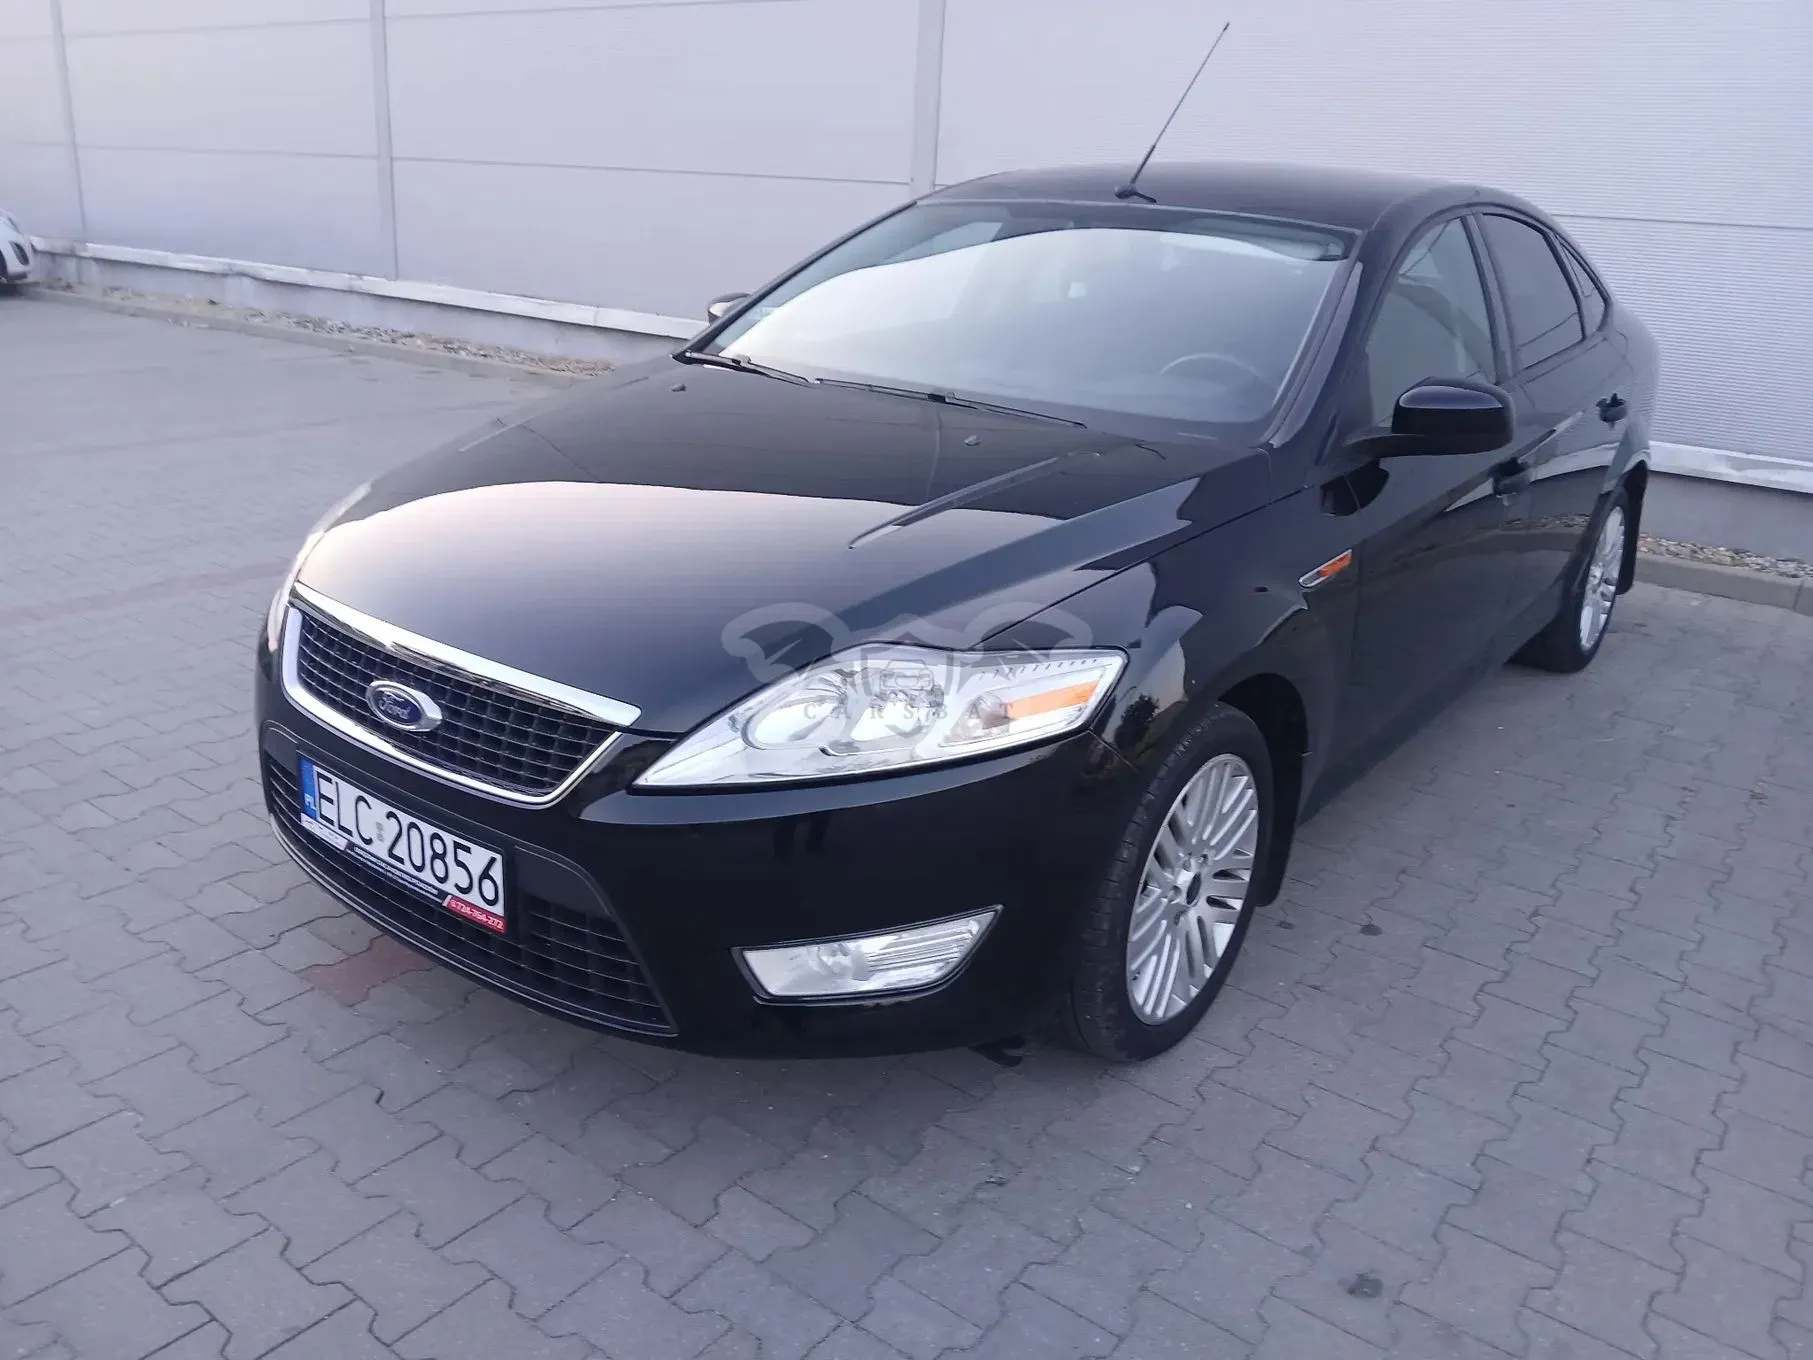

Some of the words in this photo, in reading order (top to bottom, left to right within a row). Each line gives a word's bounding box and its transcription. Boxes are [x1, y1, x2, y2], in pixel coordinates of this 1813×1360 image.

[304, 792, 317, 811] PL
[316, 772, 374, 846] ELC
[385, 810, 499, 907] 20856
